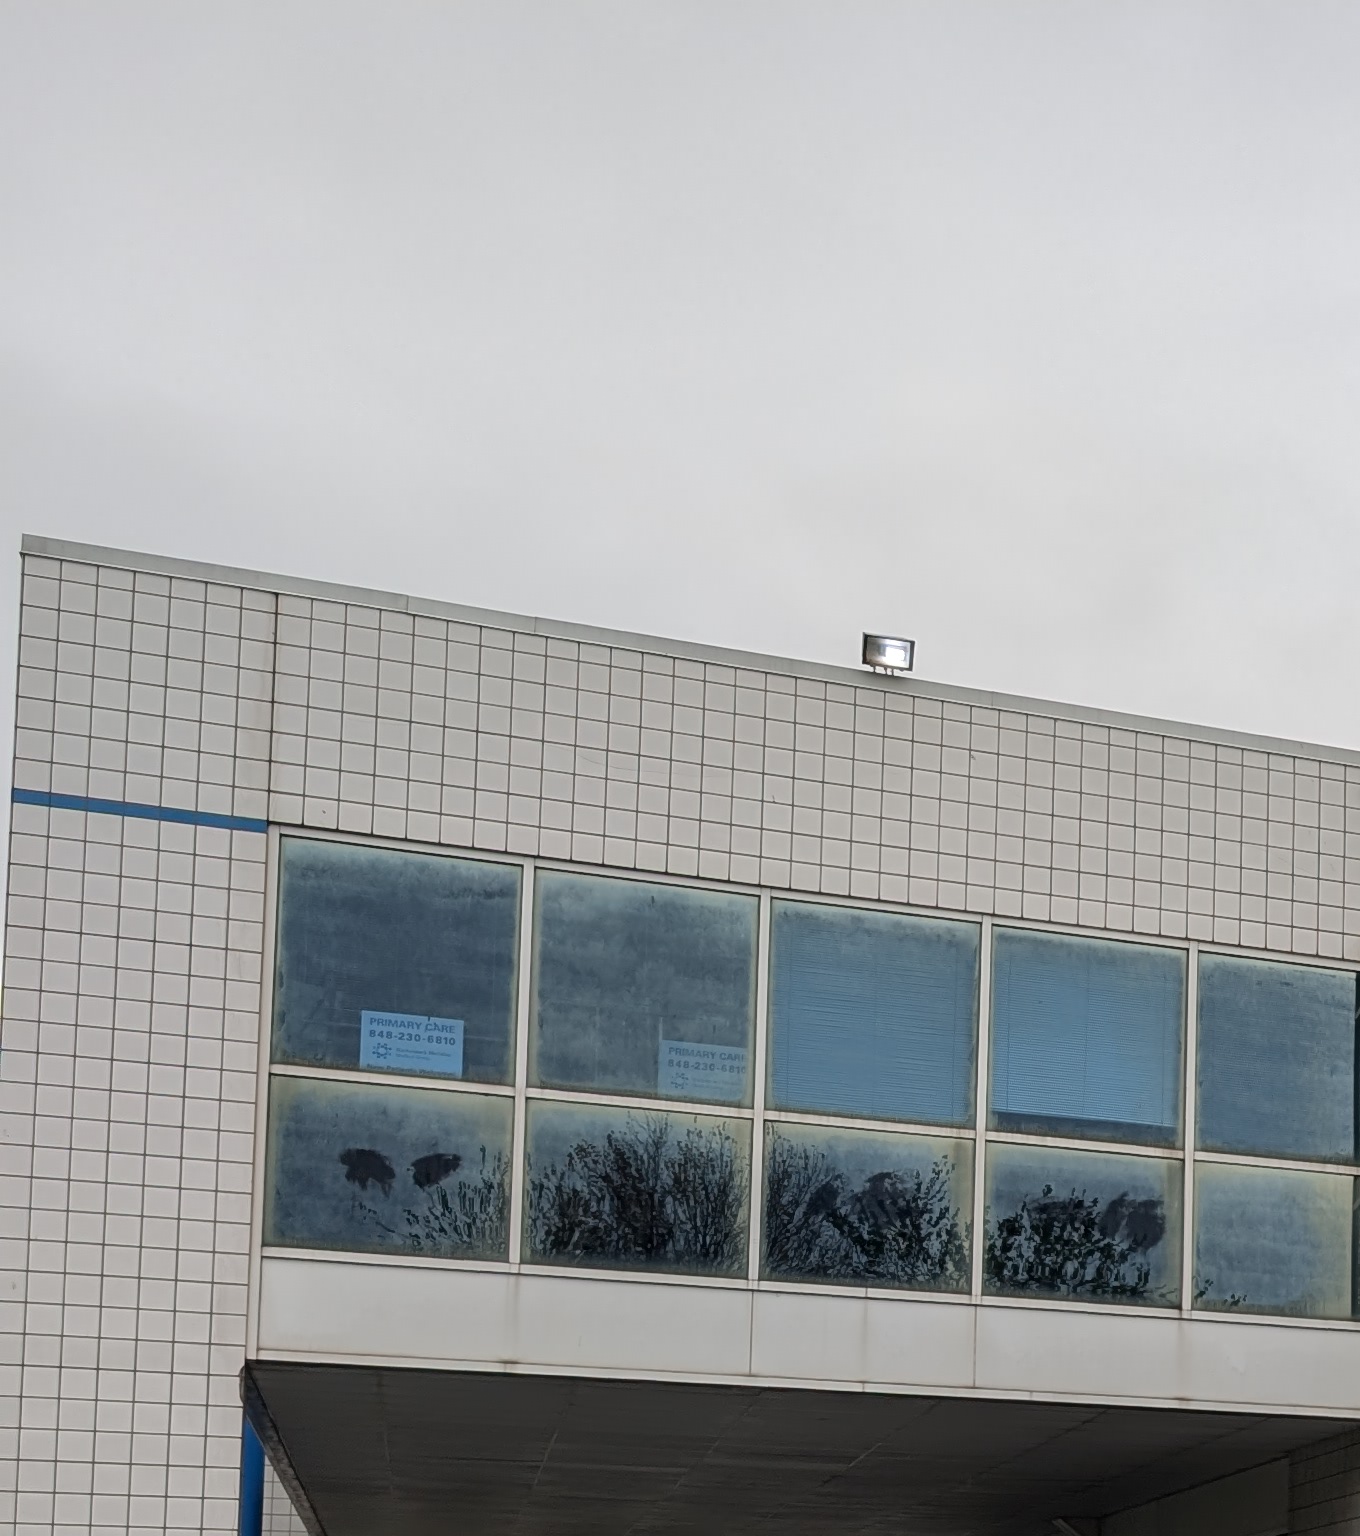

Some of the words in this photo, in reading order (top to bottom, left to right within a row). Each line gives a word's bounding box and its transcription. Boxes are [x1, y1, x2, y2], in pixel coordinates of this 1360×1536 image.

[369, 1017, 422, 1030] PRIMARY
[425, 1022, 456, 1034] CARE
[668, 1047, 717, 1060] PRIMARY
